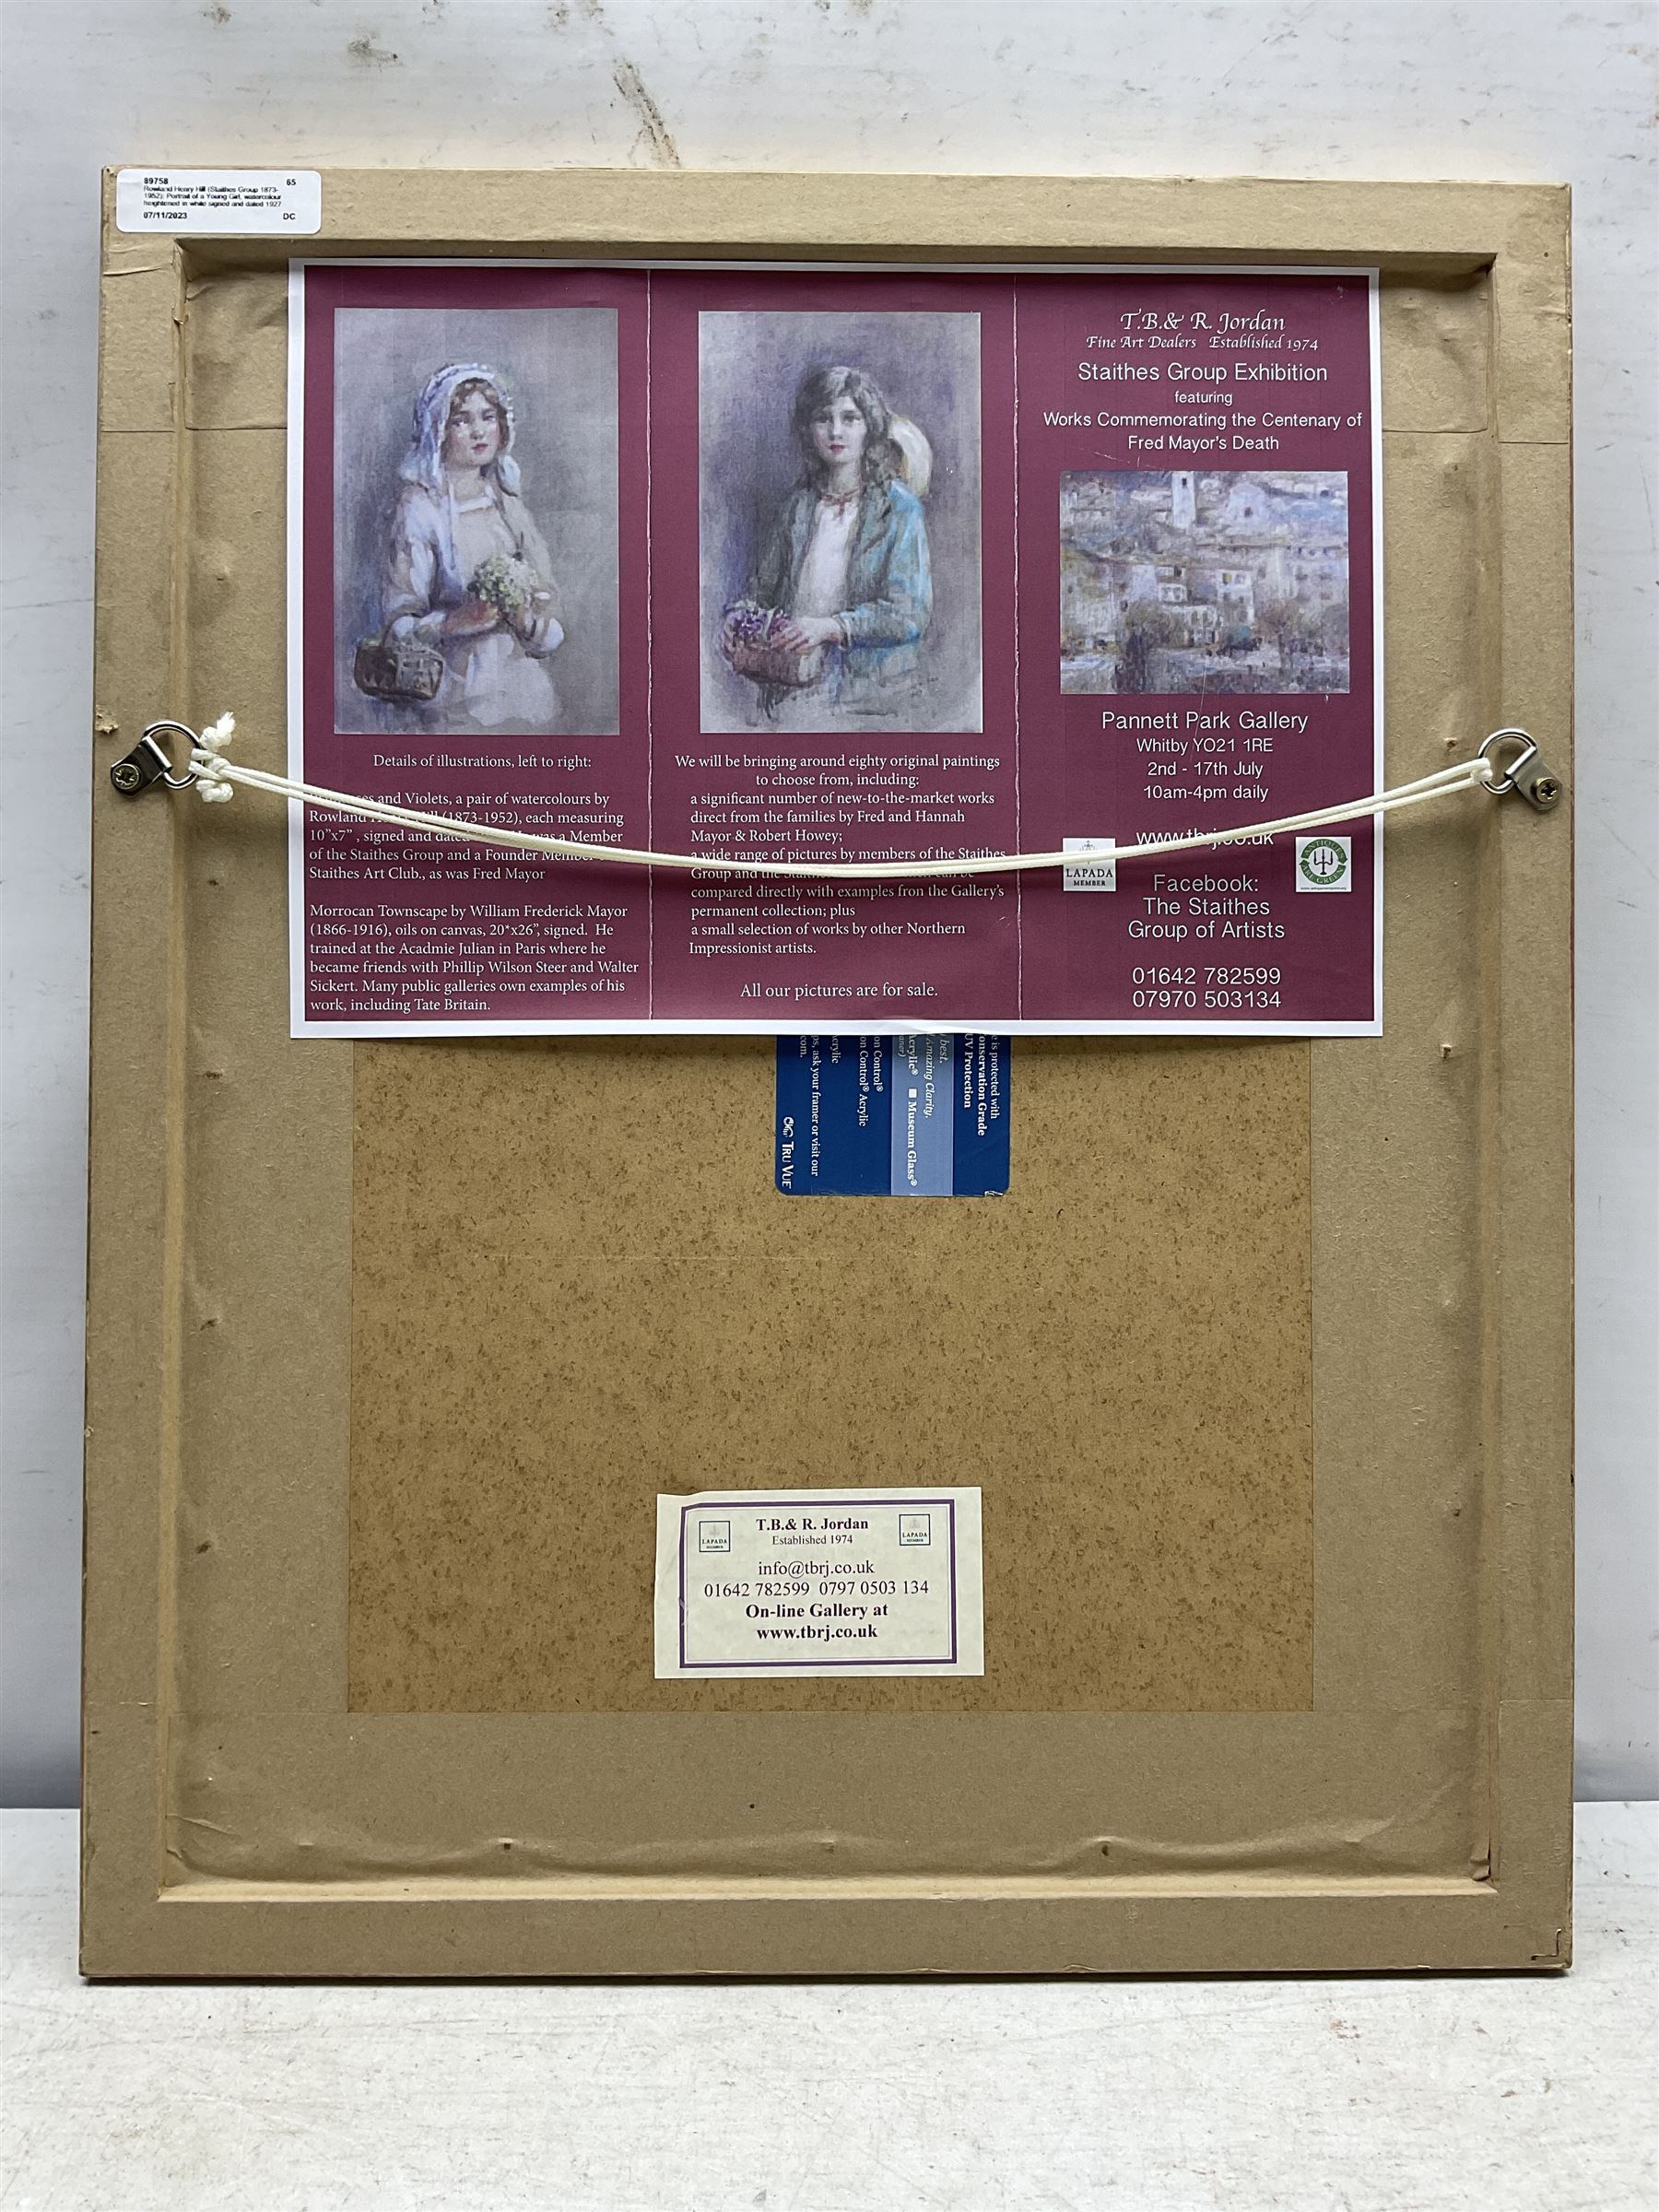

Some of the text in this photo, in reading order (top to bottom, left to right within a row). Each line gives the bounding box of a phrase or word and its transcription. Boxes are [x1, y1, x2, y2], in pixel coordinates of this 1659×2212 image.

[1121, 308, 1285, 334] T.B.& R. Jordan
[1087, 333, 1318, 351] Fine Art Dealers Established 1974
[1078, 362, 1326, 383] Staithes Group Exhibition
[1175, 391, 1232, 406] featuring
[1043, 412, 1362, 430] Works Commemorating the Centenary of
[1129, 435, 1163, 449] Fred
[1233, 436, 1278, 450] Death
[1103, 712, 1308, 733] Pannett Park Gallery
[1136, 738, 1273, 756] Whitby YO21 1RE
[373, 754, 591, 769] Details of illustrations, left to right:
[1148, 761, 1176, 775] 2nd
[1194, 761, 1227, 775] 17th
[1234, 761, 1263, 779] July
[757, 772, 919, 788] to choose from, including:
[701, 792, 764, 806] significant
[769, 792, 818, 804] number
[821, 792, 834, 804] of
[838, 792, 954, 804] new-to-the-market
[958, 792, 994, 804] works
[1144, 785, 1268, 802] 10am-4pm daily
[691, 830, 841, 845] Mayor & Robert Howey;
[1066, 868, 1112, 877] LAPADA
[1155, 875, 1258, 891] Facebook:
[311, 904, 628, 920] Morrocan Townscape by William Frederick Mayor
[1143, 898, 1269, 914] The Staithes
[1129, 921, 1284, 942] Group of Artists
[689, 942, 816, 957] Impressionist artists.
[1133, 968, 1280, 984] 01642 782599
[740, 982, 937, 1001] All our pictures are for sale.
[1134, 991, 1281, 1007] 07970 503134
[311, 998, 490, 1014] work, including Tate Britain.
[939, 1040, 949, 1064] best.
[991, 1041, 998, 1050] is
[813, 1051, 821, 1065] ask
[810, 1068, 818, 1089] your
[924, 1039, 936, 1118] Amazing Clarity.
[964, 1052, 973, 1108] Protection
[990, 1053, 1000, 1096] protected
[812, 1092, 821, 1124] framer
[858, 1094, 868, 1126] Acrylic
[991, 1099, 1000, 1119] with
[908, 1101, 916, 1148] Museum
[978, 1102, 987, 1135] Grade
[812, 1125, 818, 1135] or
[812, 1138, 820, 1158] visit
[756, 1518, 868, 1530] T.B.& R. Jordan
[773, 1535, 853, 1545] Established 1974
[759, 1560, 875, 1579] info@tbrj.co.uk
[705, 1581, 928, 1597] 01642 782599 0797 0503 134
[746, 1604, 888, 1619] On-line Gallery at
[757, 1624, 877, 1641] www.tbrj.co.uk
